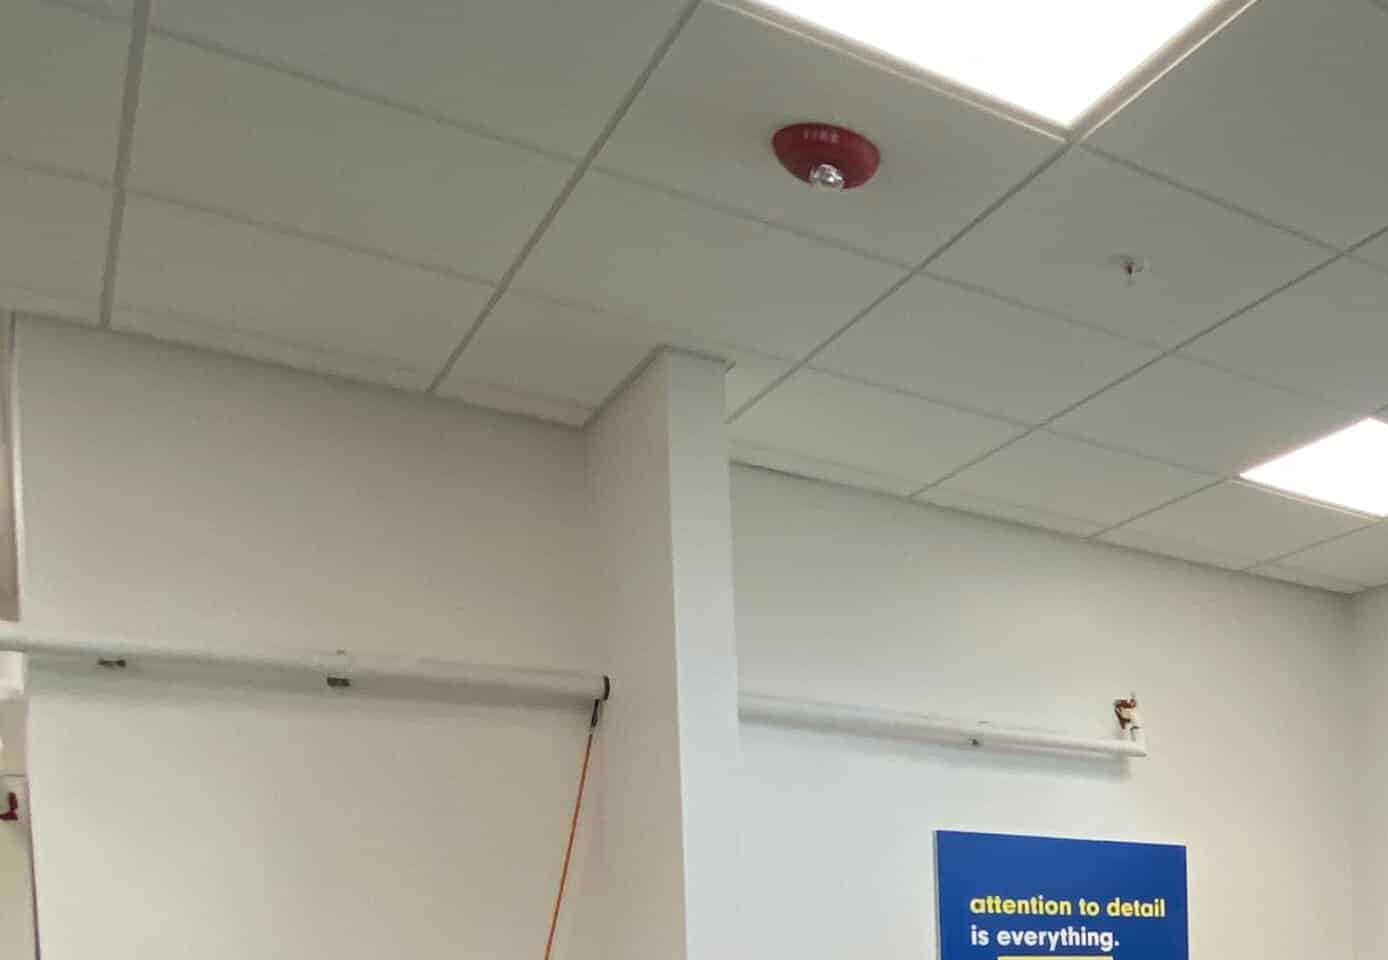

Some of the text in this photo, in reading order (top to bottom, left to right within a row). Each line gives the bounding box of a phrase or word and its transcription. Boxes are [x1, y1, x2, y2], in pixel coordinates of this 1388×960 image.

[969, 895, 1166, 918] attention to detail
[970, 925, 1120, 952] is everything.
